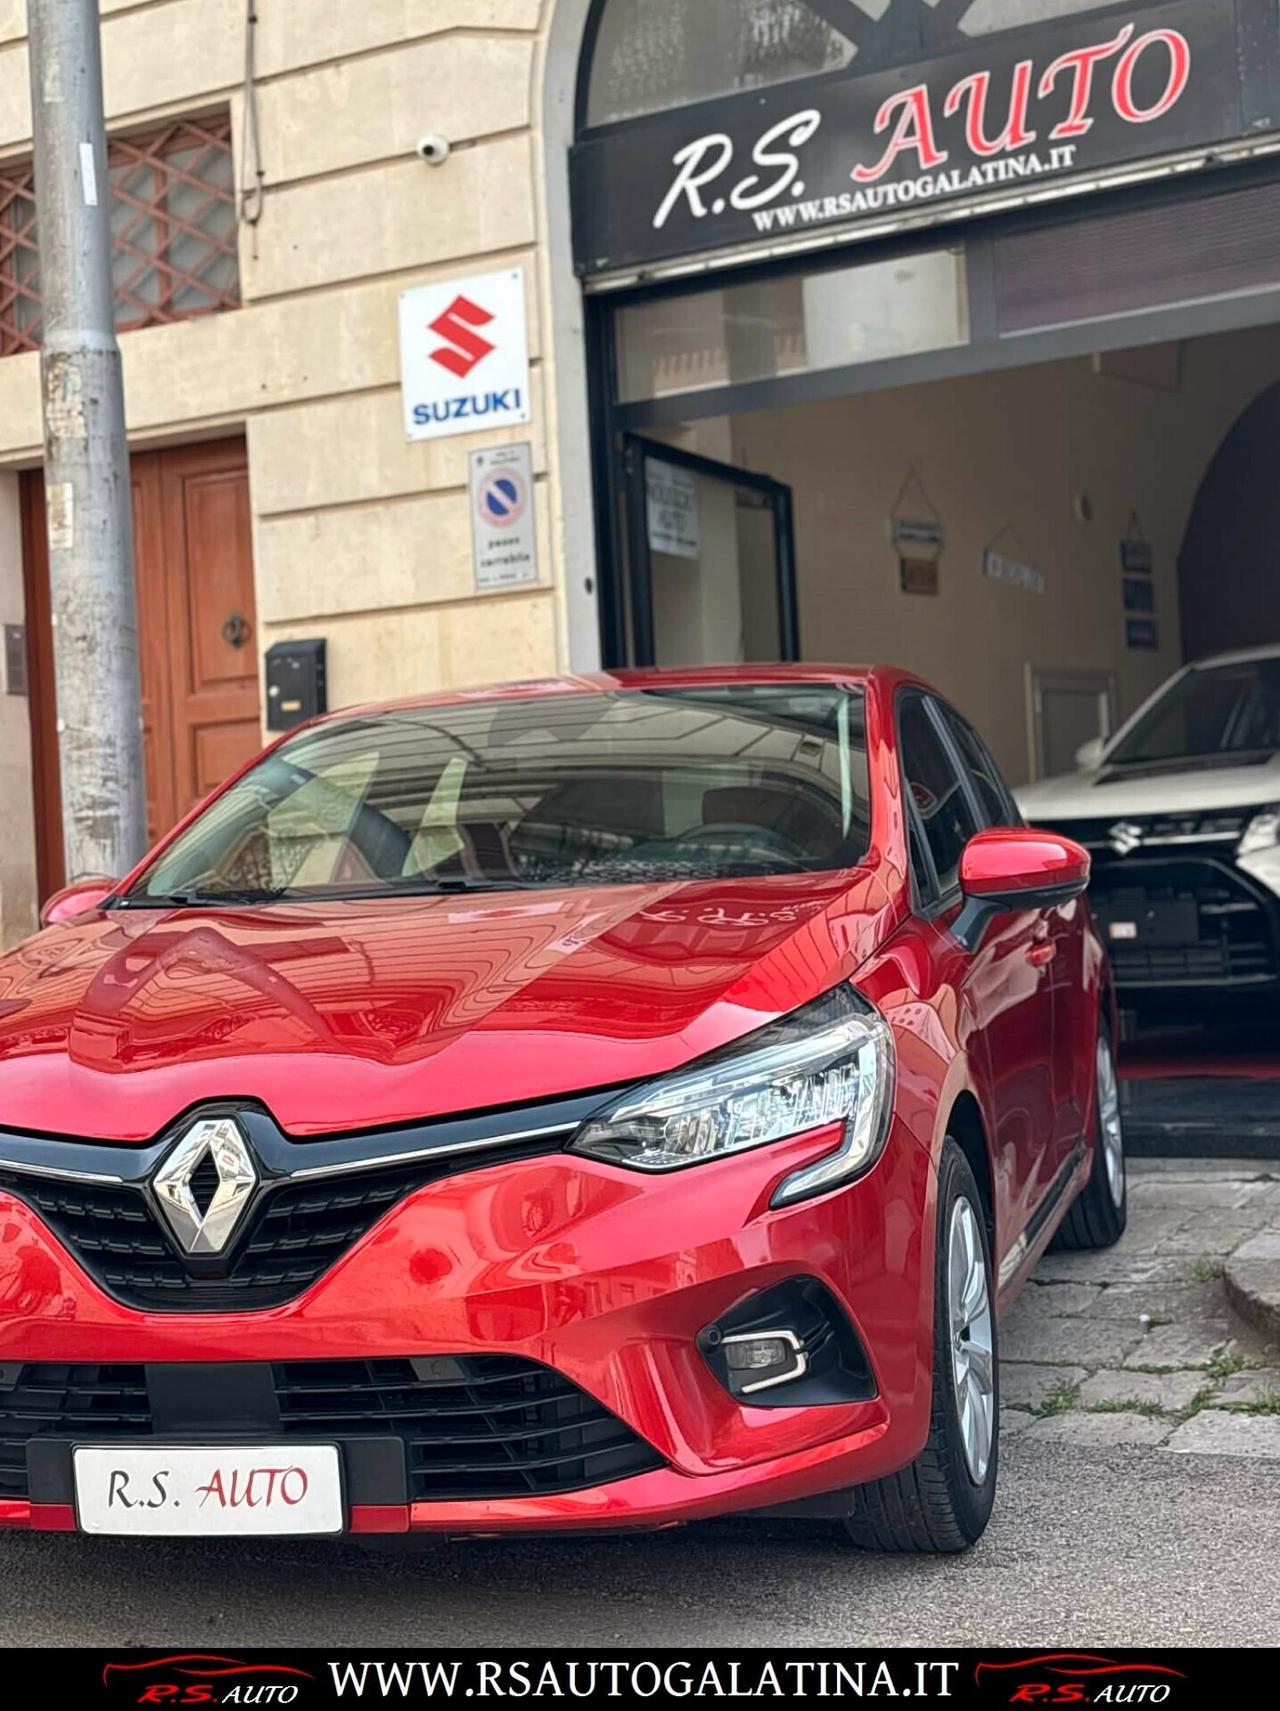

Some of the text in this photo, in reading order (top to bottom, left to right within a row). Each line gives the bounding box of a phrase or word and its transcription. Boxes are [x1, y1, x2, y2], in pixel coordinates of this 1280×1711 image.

[652, 22, 1189, 228] R.S. AUTO
[752, 144, 1077, 232] WWW.RSAUTOGALATINA.IT
[412, 388, 521, 425] SUZUKI
[108, 1465, 309, 1508] R.S. AUTO
